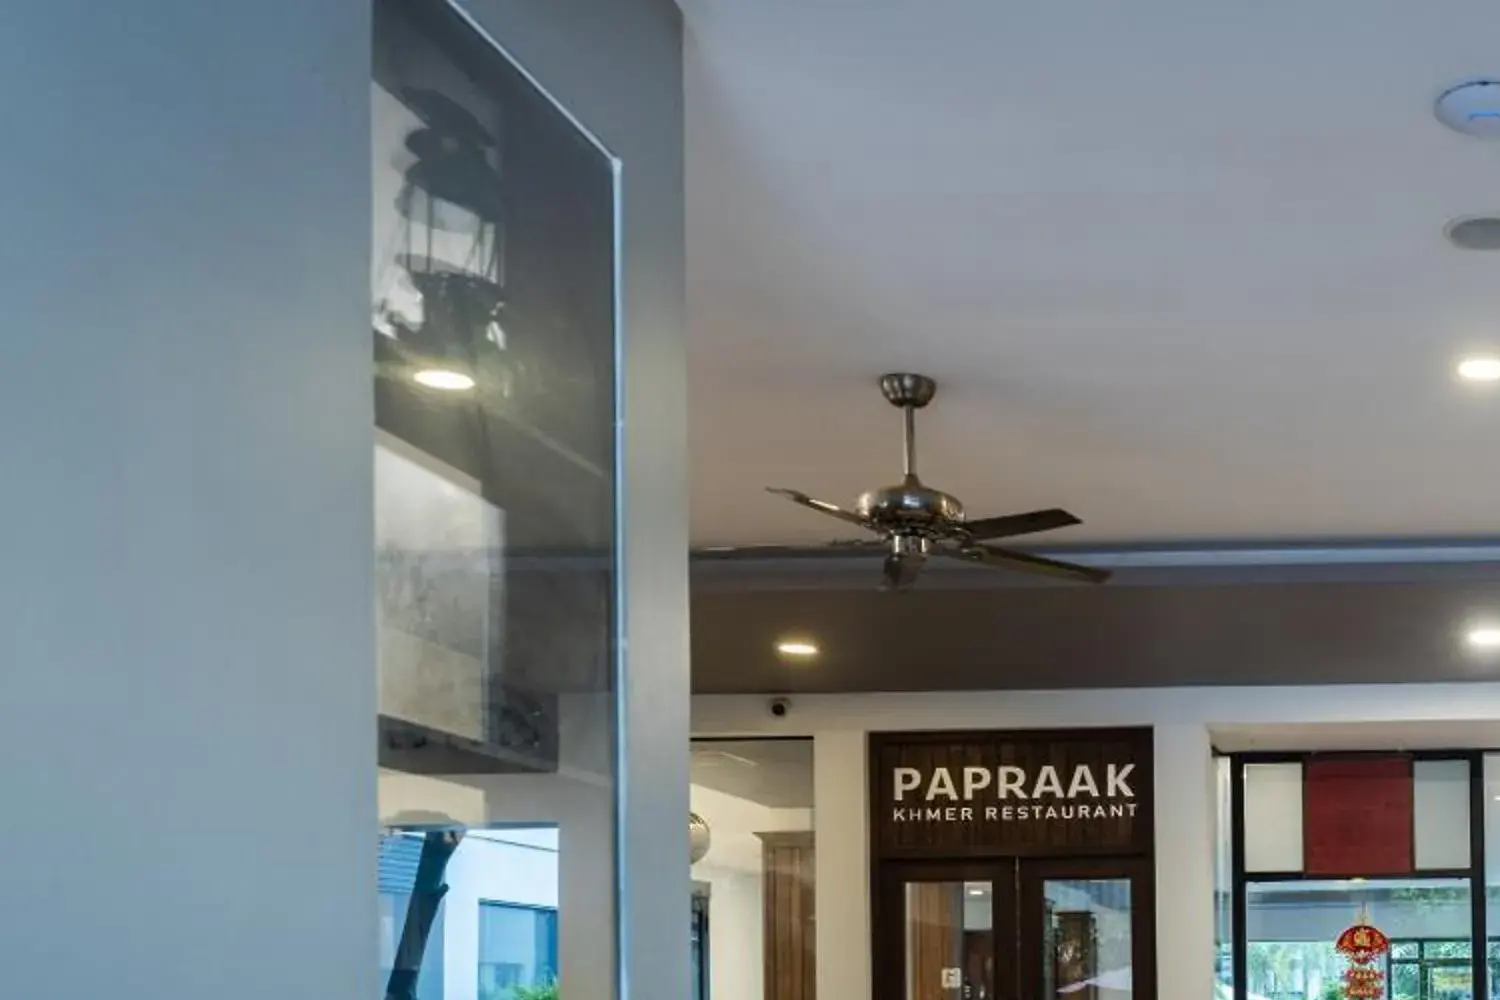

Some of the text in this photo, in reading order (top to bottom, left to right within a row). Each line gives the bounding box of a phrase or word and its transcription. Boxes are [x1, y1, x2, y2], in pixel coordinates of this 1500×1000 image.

[893, 763, 1137, 801] PAPRAAK
[893, 803, 1139, 822] KHMER RESTAURANT
